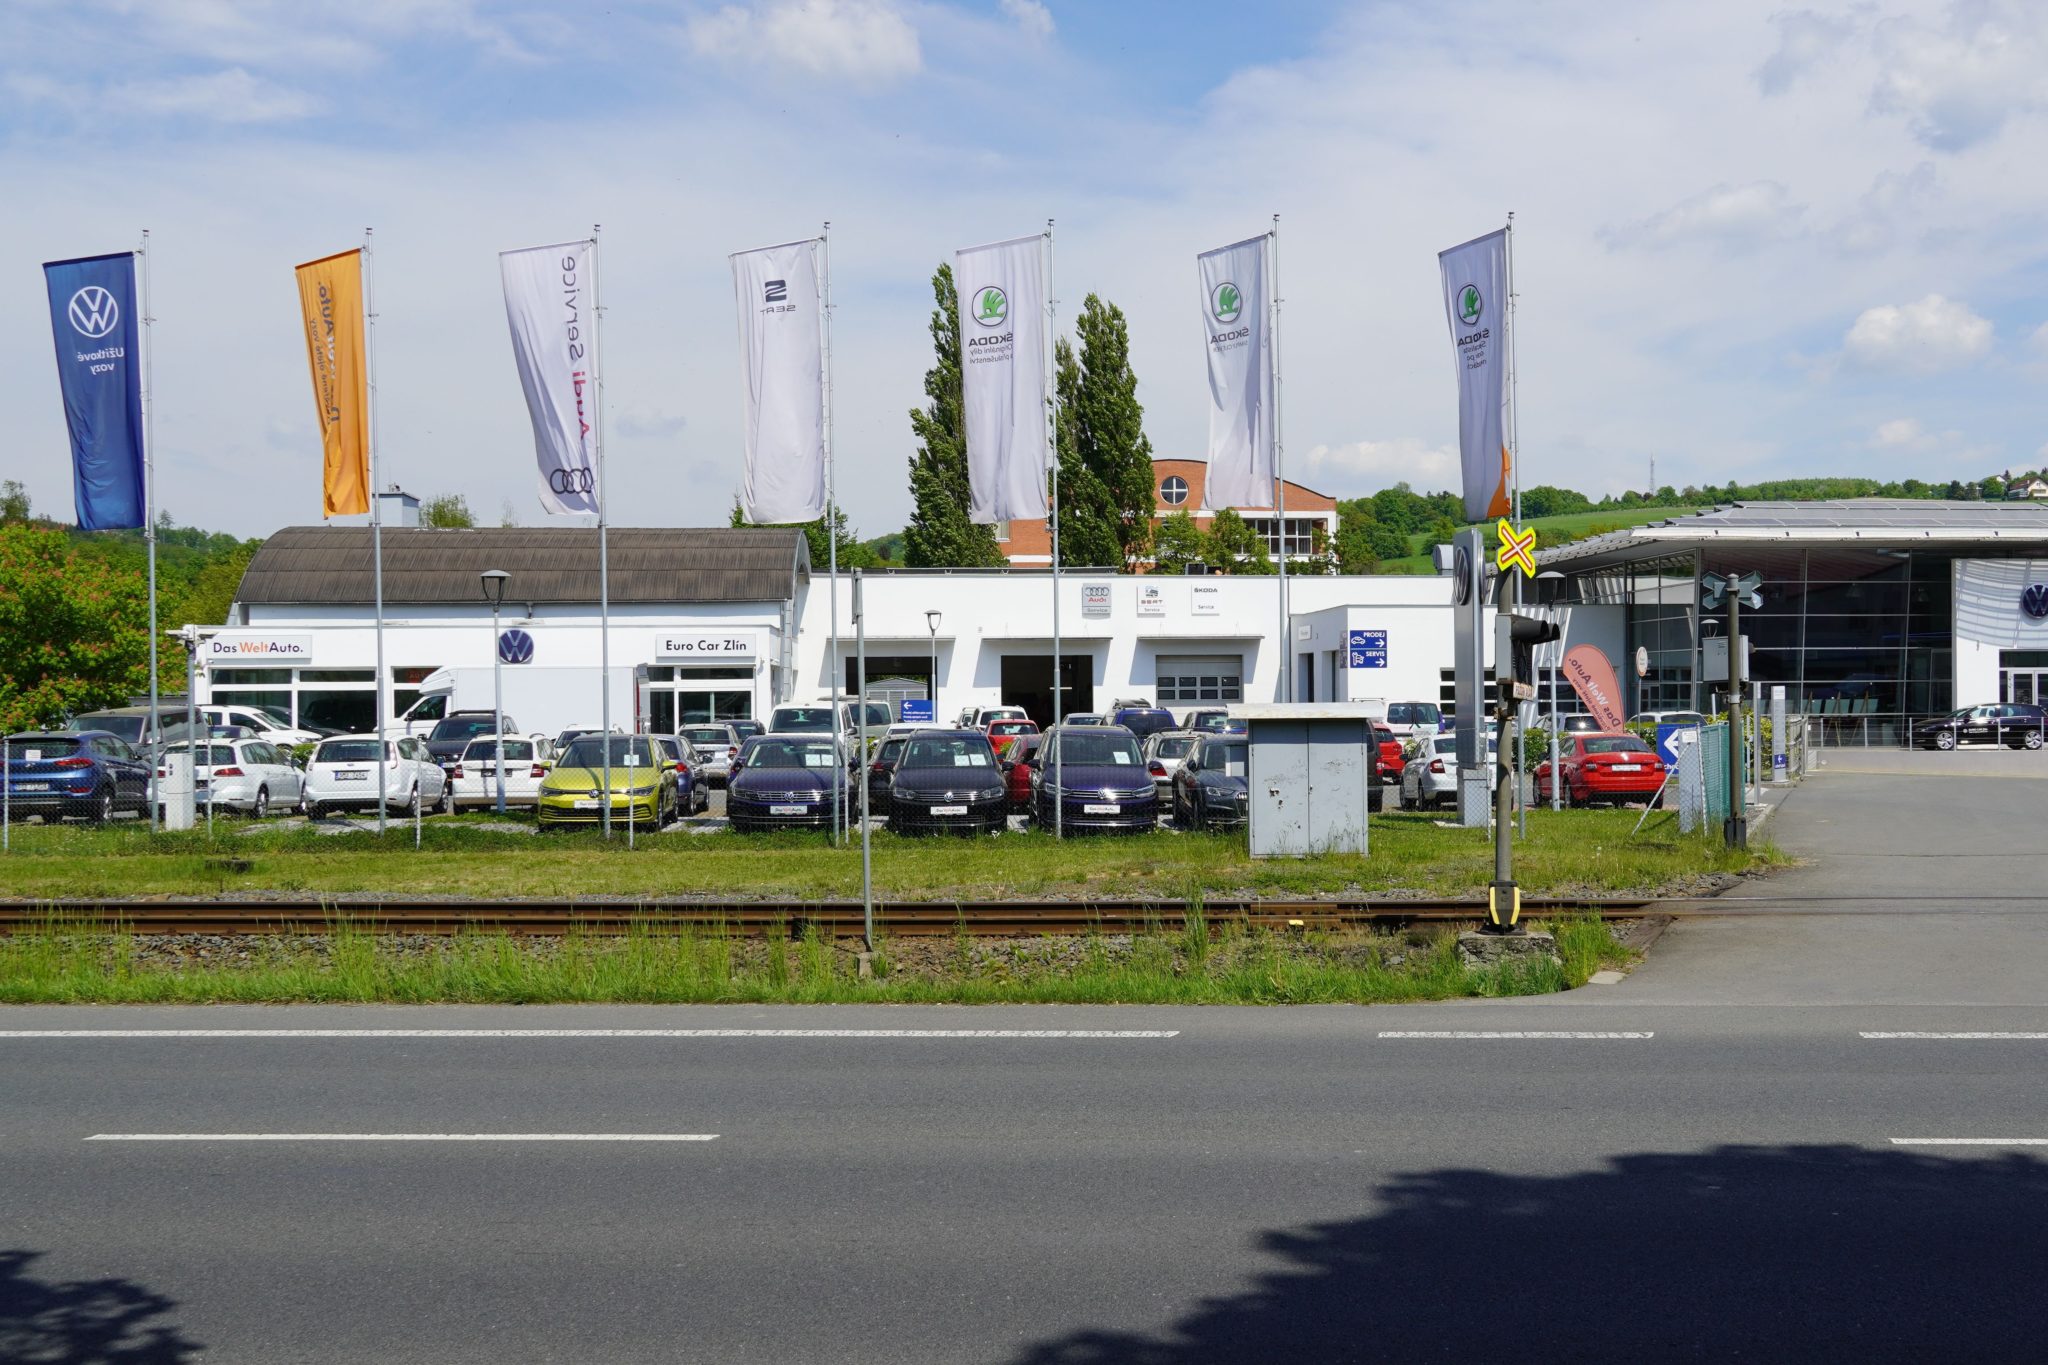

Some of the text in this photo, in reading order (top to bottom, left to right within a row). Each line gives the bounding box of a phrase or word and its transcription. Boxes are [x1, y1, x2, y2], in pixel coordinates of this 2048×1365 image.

[213, 641, 304, 653] Das WeltAuto.
[665, 639, 747, 651] Euro Car Zlín
